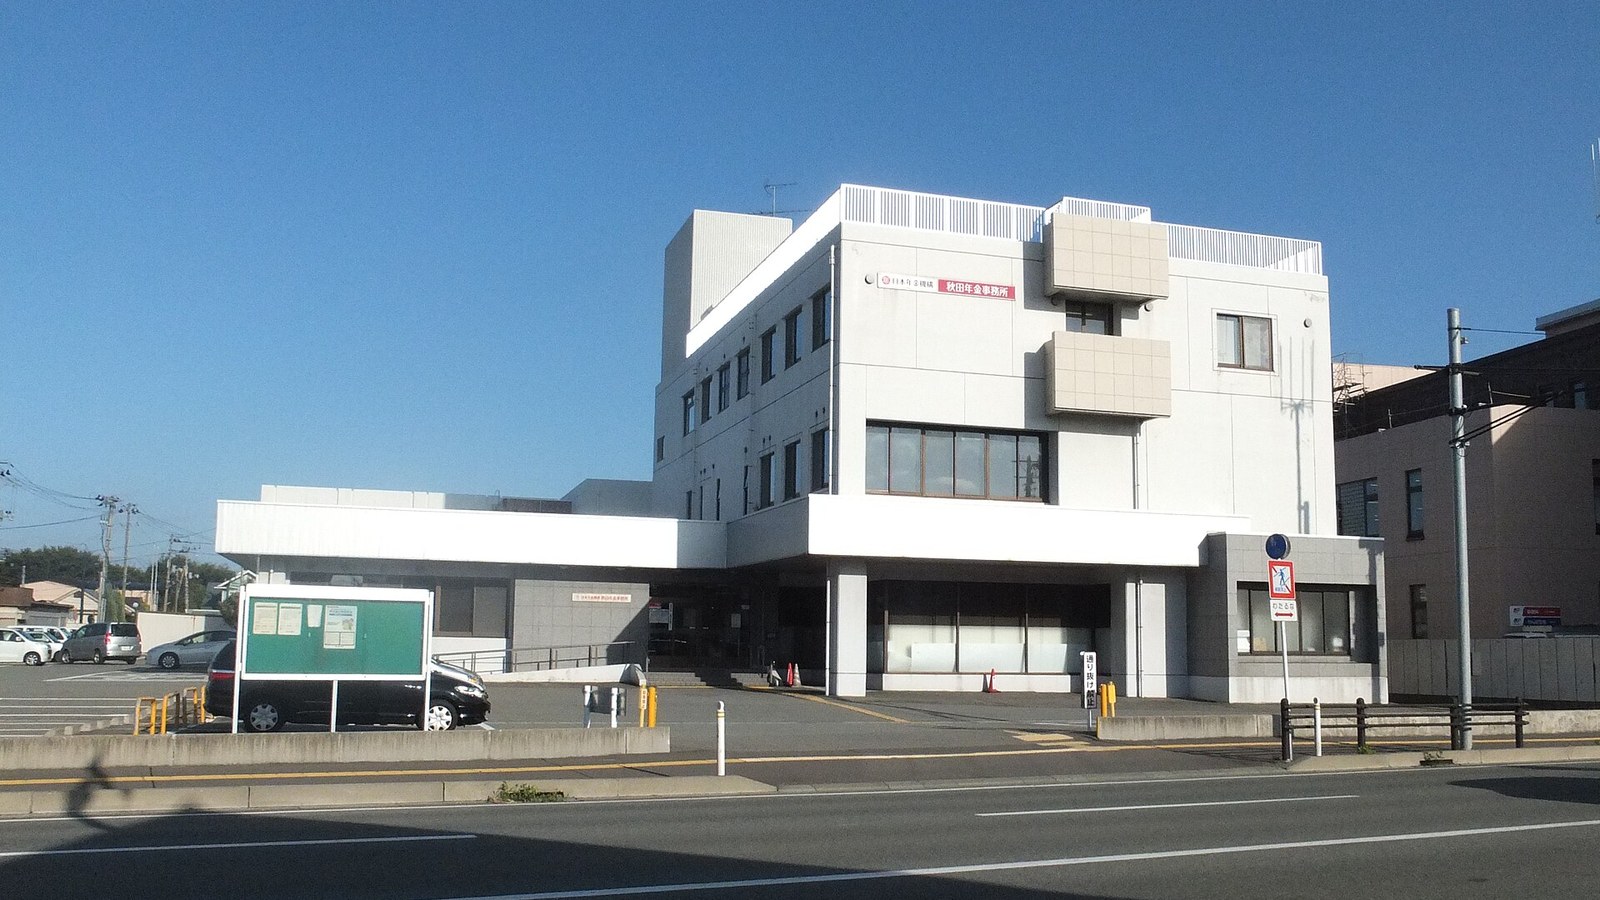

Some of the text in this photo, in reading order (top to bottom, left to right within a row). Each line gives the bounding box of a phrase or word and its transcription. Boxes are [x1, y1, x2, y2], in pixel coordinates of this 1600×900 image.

[946, 281, 1009, 298] 秋田年金事務所
[1272, 602, 1295, 610] わたるな
